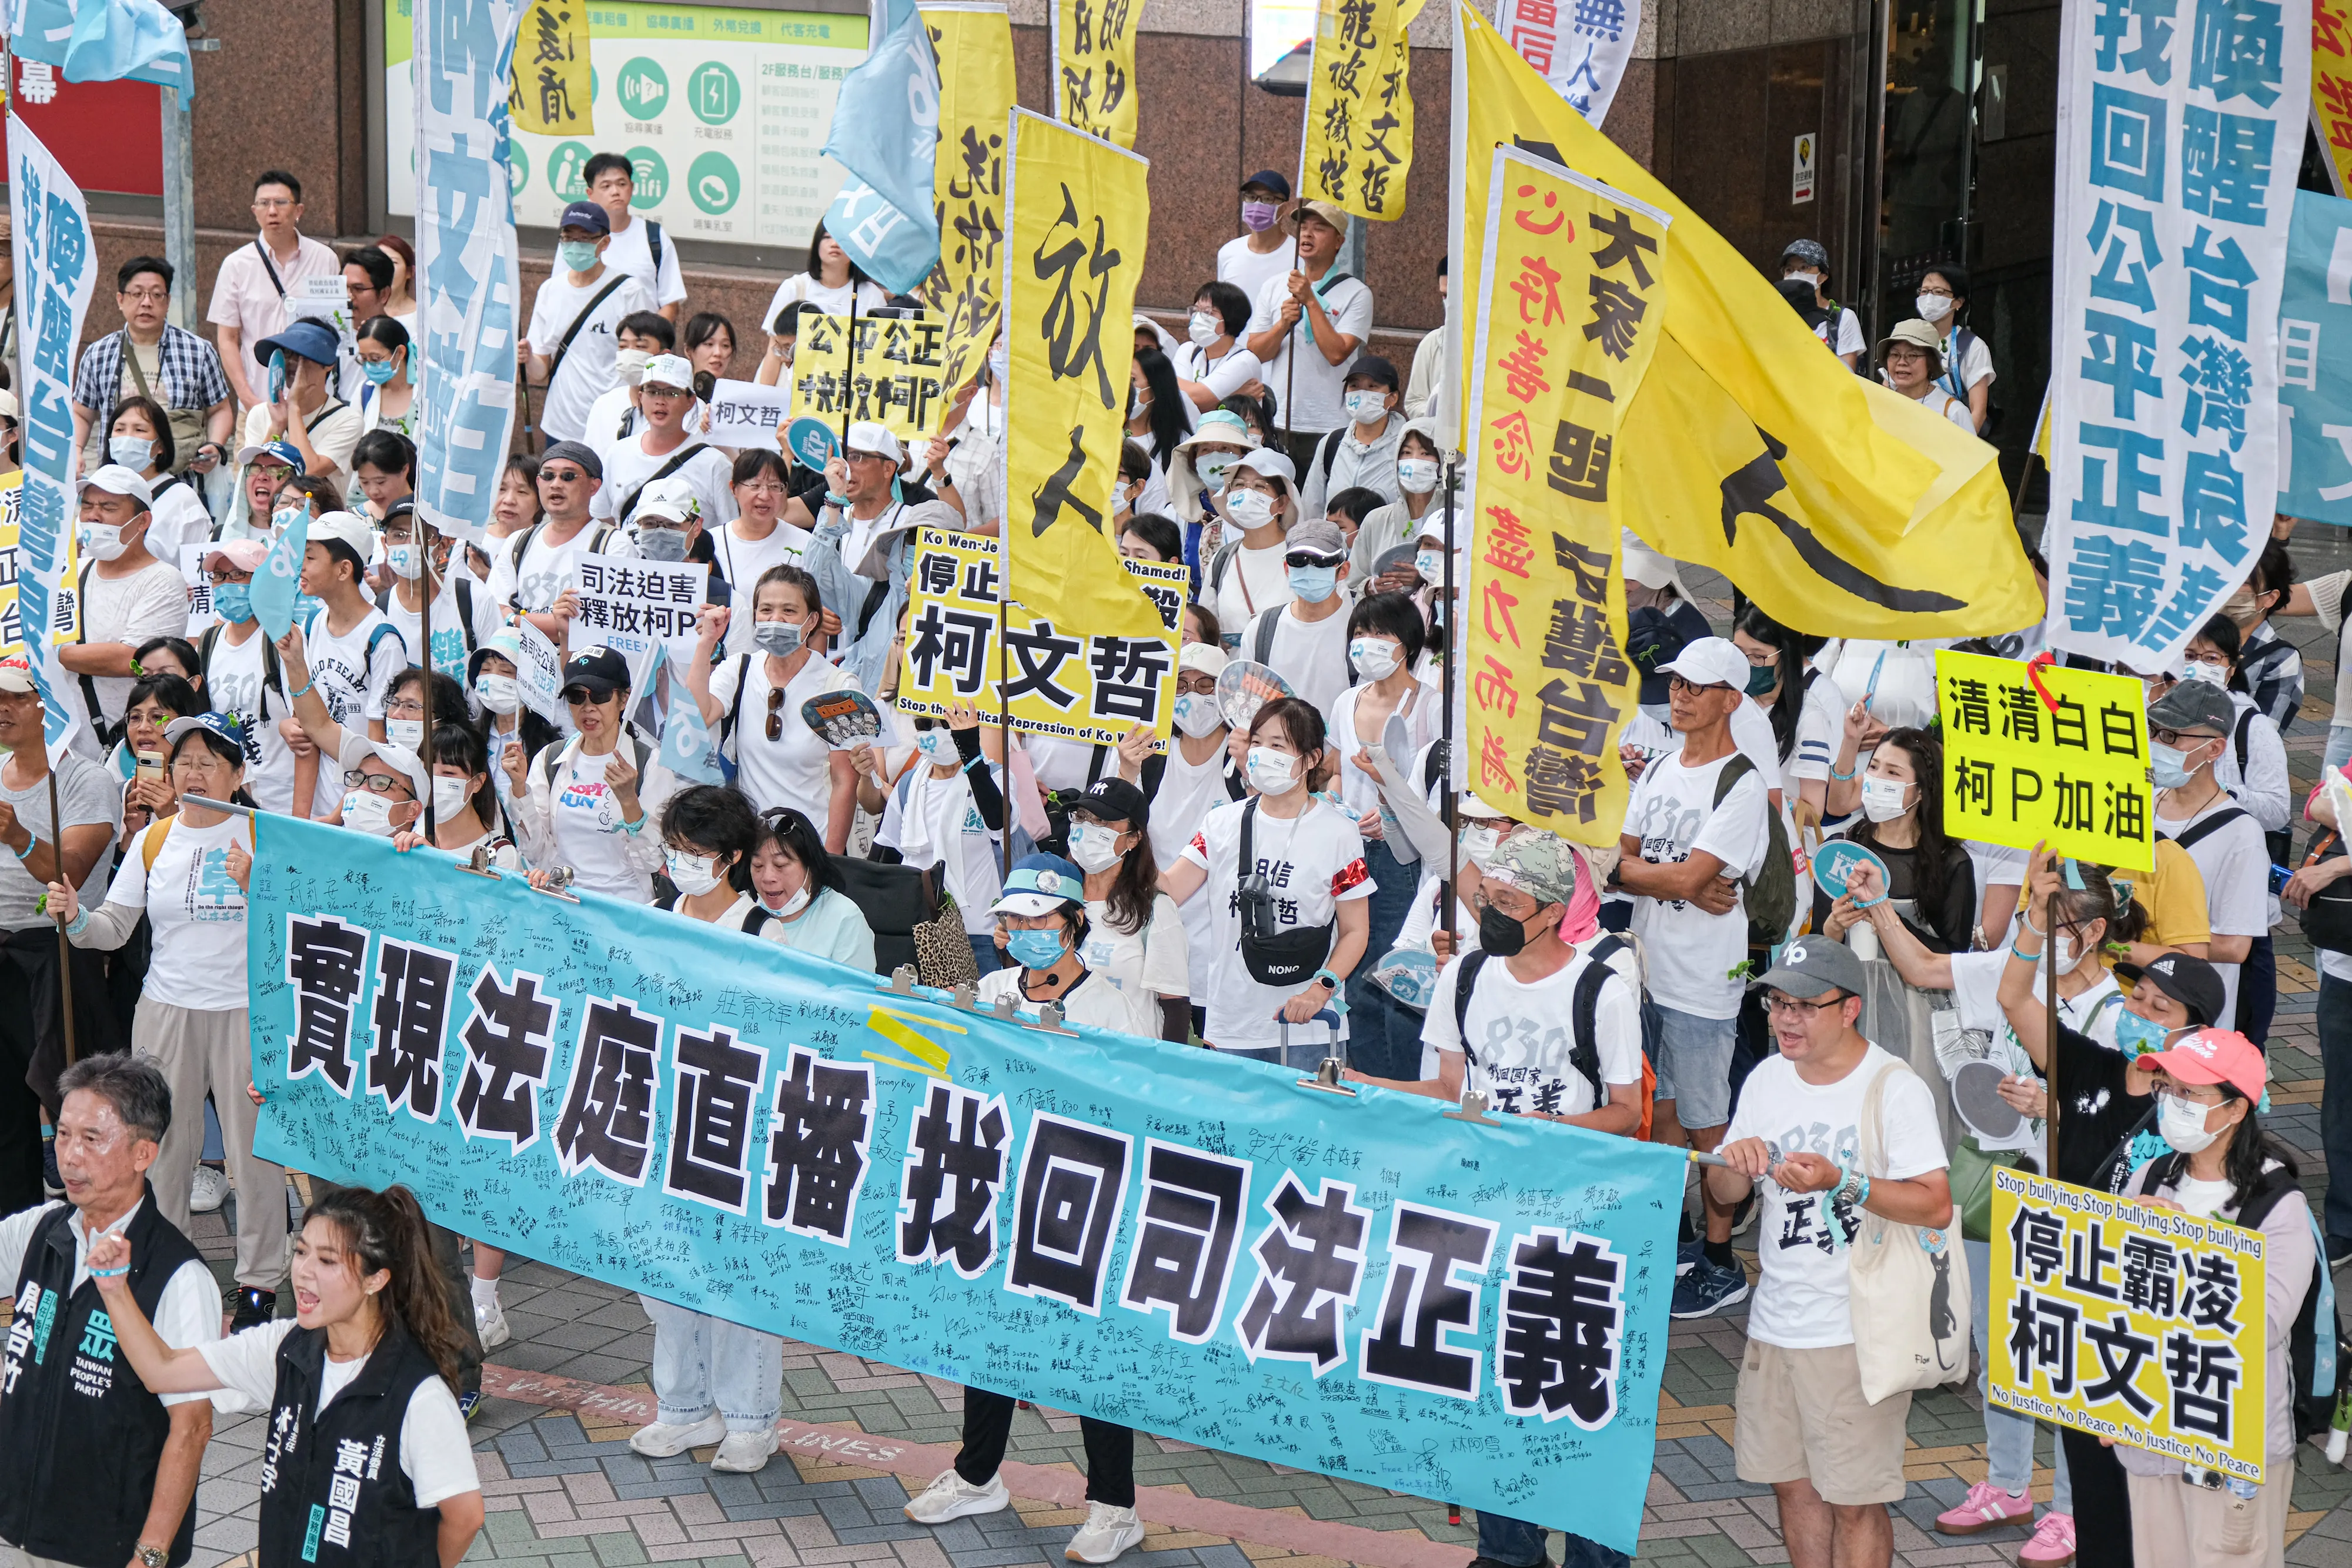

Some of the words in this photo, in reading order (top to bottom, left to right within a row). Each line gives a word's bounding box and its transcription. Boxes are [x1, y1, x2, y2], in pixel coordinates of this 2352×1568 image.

[780, 21, 831, 39] 代客充電
[694, 127, 734, 141] 充電服務
[2065, 0, 2176, 643] 找回公平正義
[808, 315, 944, 367] 公平公正
[1032, 182, 1121, 537] 放人
[716, 400, 781, 427] 柯文哲
[807, 430, 827, 464] KP
[924, 530, 943, 545] Ko
[947, 534, 998, 553] Wen-Je
[1124, 560, 1187, 581] Shamed!
[582, 563, 696, 604] 司法迫害
[579, 596, 696, 637] 釋放柯P
[519, 631, 557, 678] 為司法公義
[607, 636, 642, 653] FREE
[910, 604, 1171, 722] 柯文哲
[335, 660, 368, 693] HEART
[532, 664, 555, 697] 站出來
[348, 704, 361, 713] 1993
[900, 697, 927, 713] Stop
[1008, 716, 1075, 736] Repression
[1078, 727, 1093, 738] of
[1095, 729, 1112, 743] Ko
[1948, 676, 2140, 760] 清清白白
[1954, 755, 2144, 843] 柯P加油
[1268, 964, 1300, 976] NONO
[1479, 1016, 1569, 1076] 830
[874, 1075, 900, 1092] Jeremy
[900, 1079, 916, 1094] Ray
[1061, 1100, 1079, 1114] 830
[1248, 1127, 1277, 1142] David
[1997, 1171, 2025, 1197] Stop
[2207, 1224, 2263, 1258] bullying
[2011, 1206, 2243, 1335] 停止霸凌
[679, 1290, 702, 1305] Stella
[69, 1367, 112, 1389] PEOPLE'S
[75, 1356, 113, 1377] TAIWAN
[970, 1372, 1026, 1391] 阿伯加油!
[2010, 1289, 2241, 1442] 柯文哲
[74, 1382, 106, 1398] PARTY
[1450, 1435, 1501, 1453] 林阿雪
[1992, 1384, 2009, 1402] No
[2011, 1389, 2053, 1416] justice
[2057, 1405, 2074, 1423] No
[2146, 1431, 2191, 1458] justice
[2196, 1444, 2214, 1463] No
[2219, 1450, 2260, 1476] Peace
[366, 1434, 386, 1481] 立法委員
[323, 1438, 369, 1549] 黃國昌
[305, 1508, 322, 1558] 服務團隊
